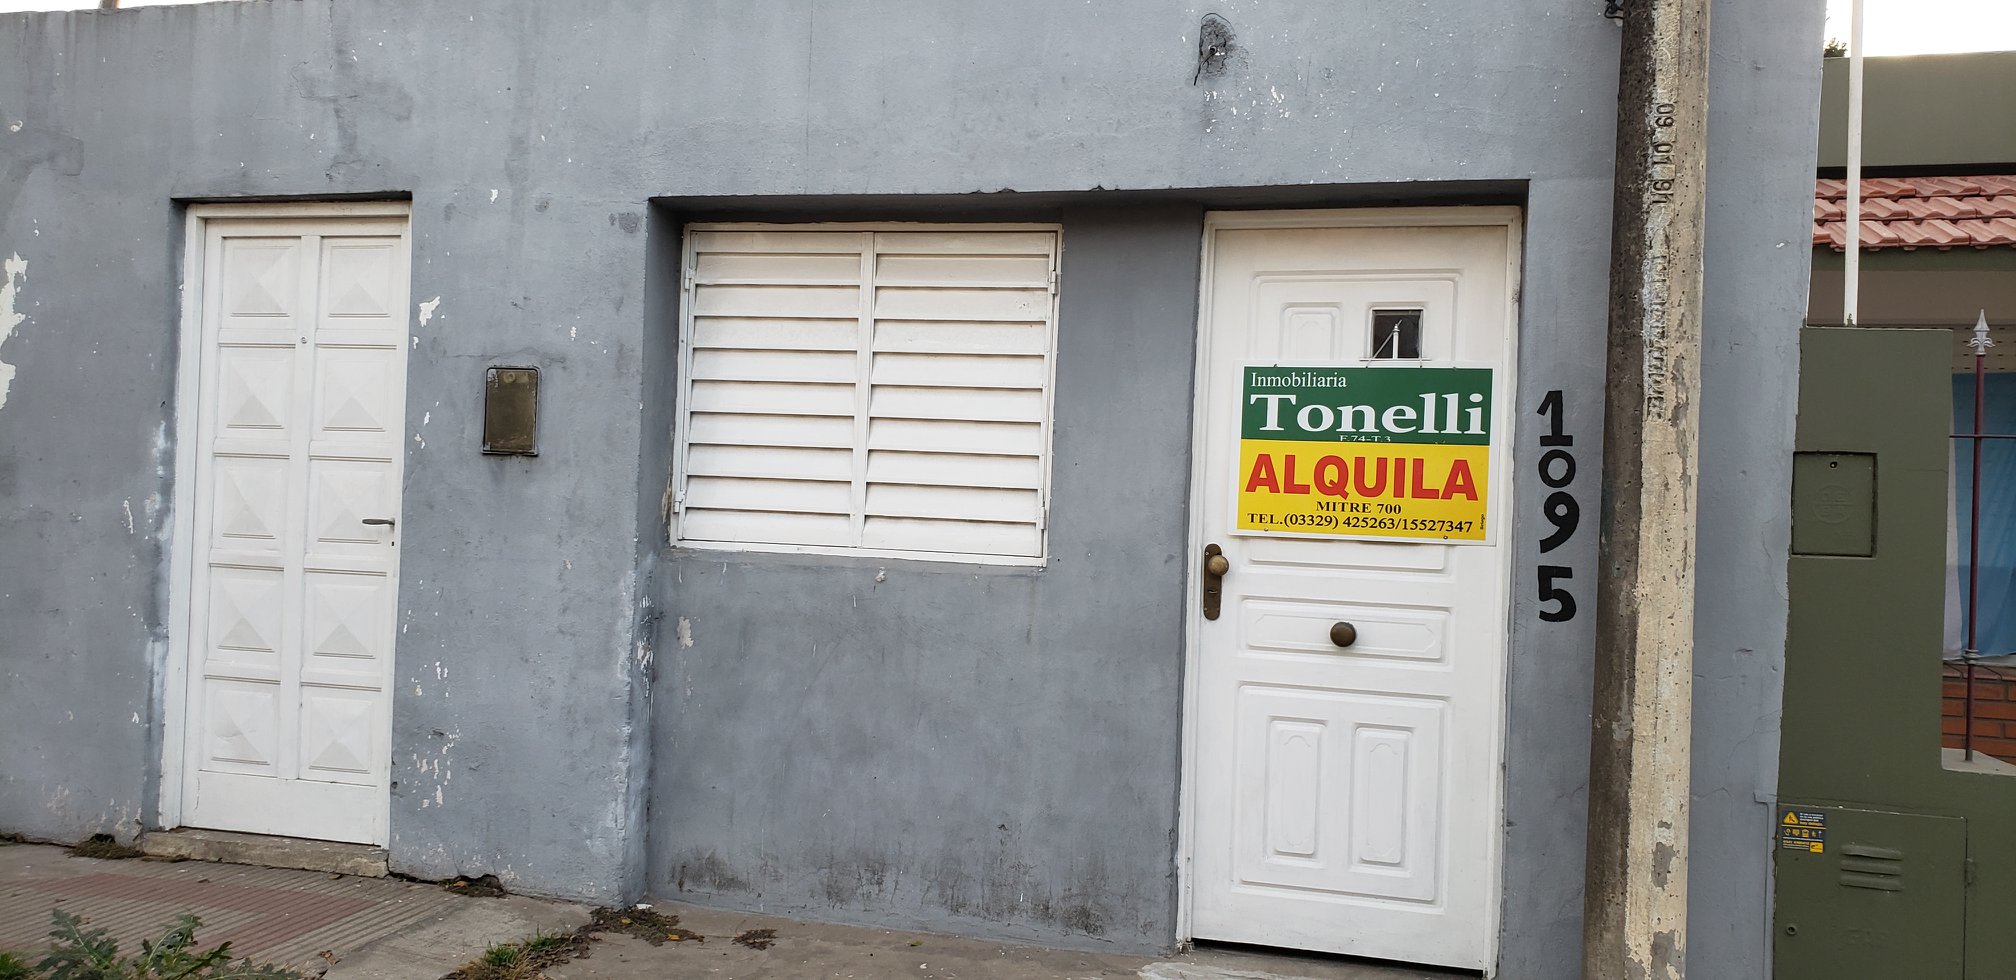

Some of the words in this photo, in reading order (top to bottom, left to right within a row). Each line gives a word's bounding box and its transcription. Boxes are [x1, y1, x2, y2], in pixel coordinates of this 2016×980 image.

[1250, 372, 1347, 388] Inmobiliaria
[1249, 392, 1487, 435] Tonelli
[1245, 453, 1479, 501] ALQUILA
[1316, 501, 1372, 514] MITRE
[1377, 503, 1402, 515] 700
[1537, 390, 1580, 623] 1095
[1247, 513, 1339, 528] TEL.(03329)
[1343, 517, 1473, 533] 425263/15527347
